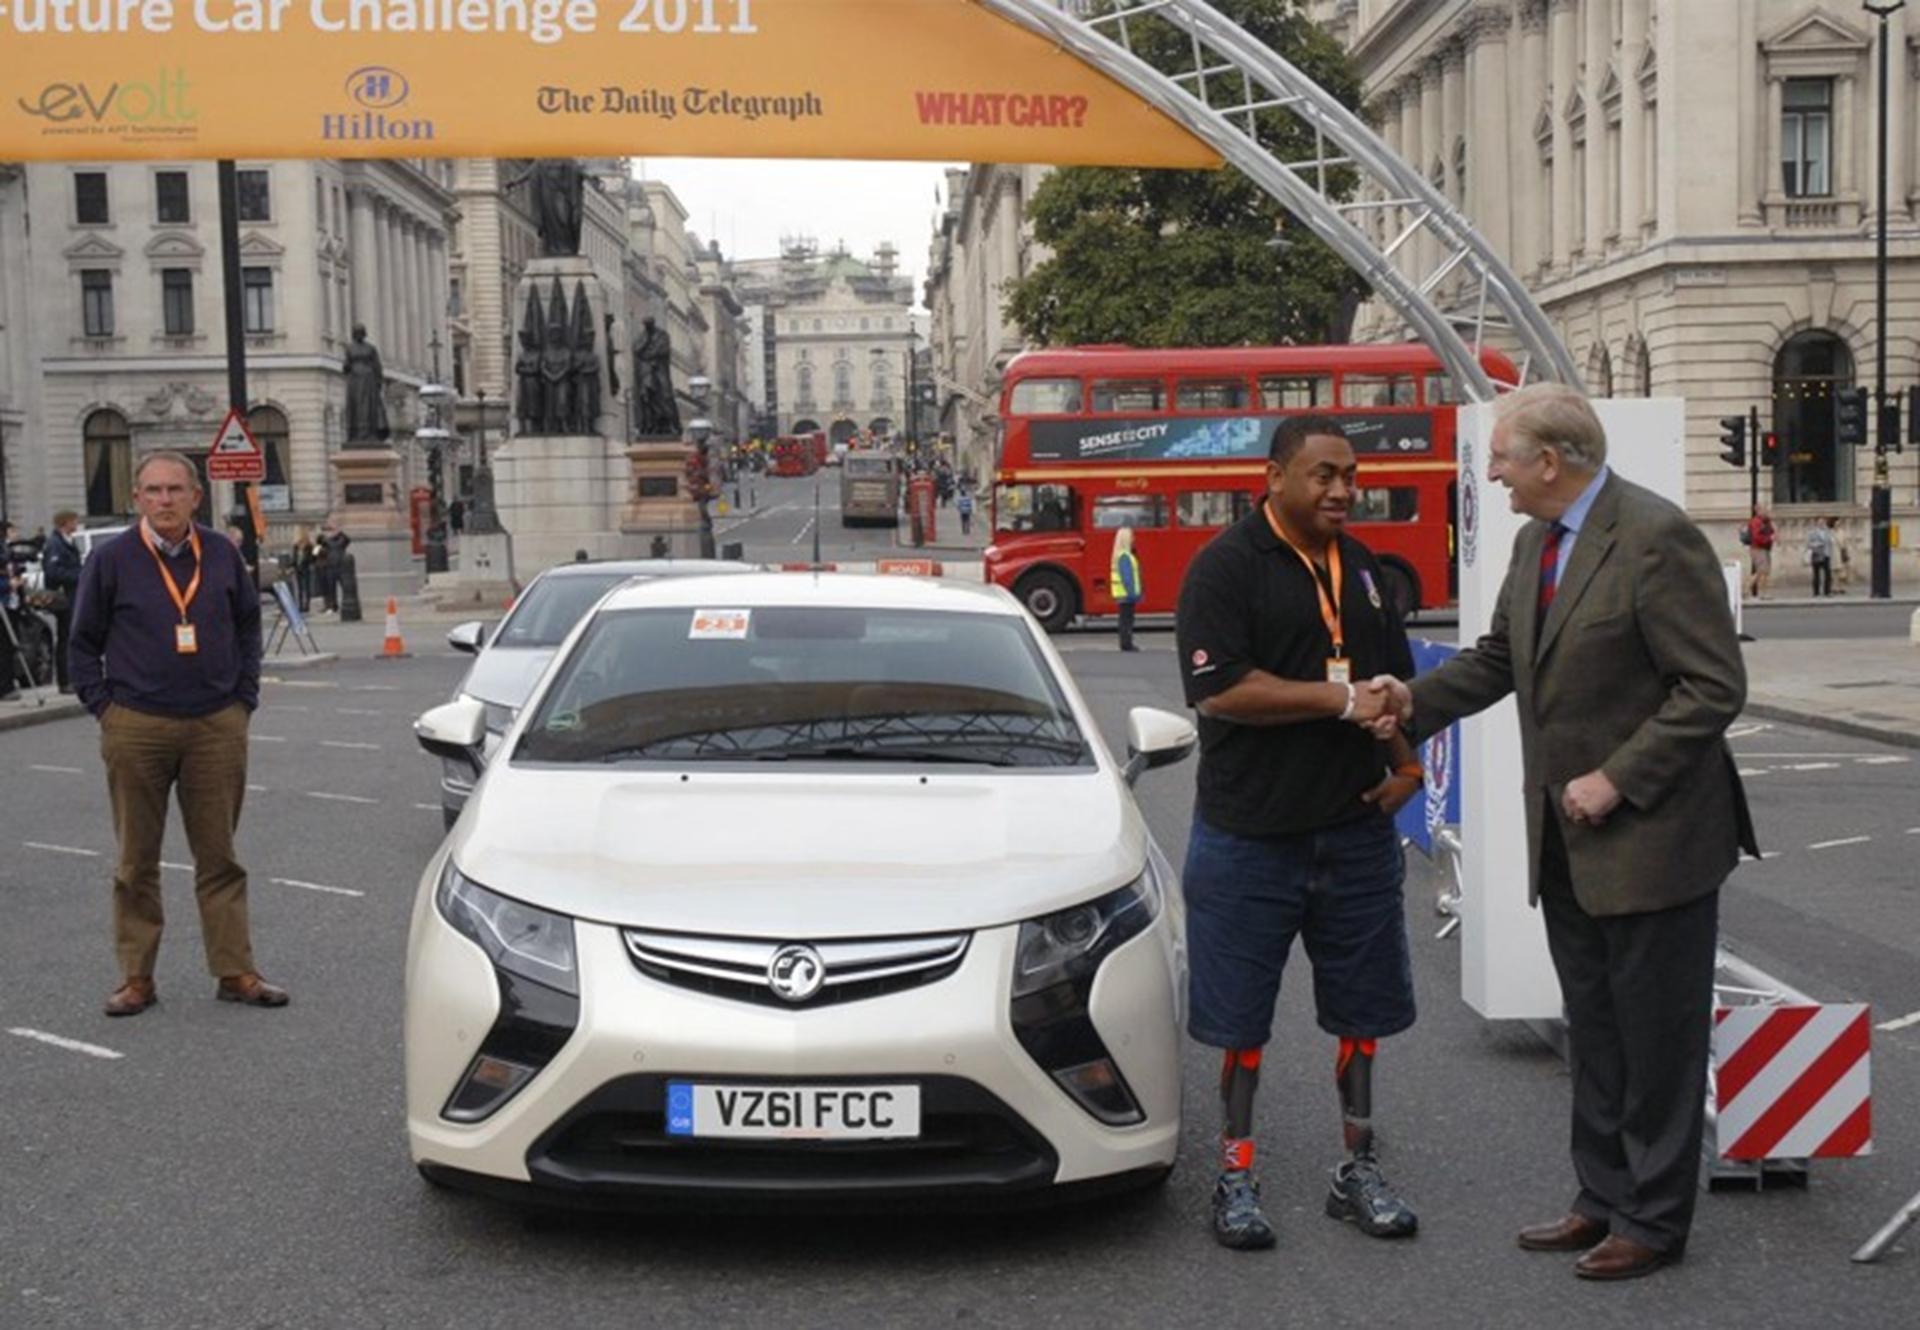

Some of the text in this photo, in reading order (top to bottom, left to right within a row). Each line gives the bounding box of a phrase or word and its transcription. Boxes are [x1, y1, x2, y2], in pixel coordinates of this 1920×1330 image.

[194, 0, 291, 32] Car
[309, 0, 597, 43] Challenge
[618, 0, 757, 33] 2011
[537, 86, 823, 121] The Daily Telegraph
[323, 112, 434, 140] Hilton
[1079, 431, 1121, 450] SENSE
[1136, 424, 1168, 440] CITY
[715, 1090, 893, 1128] VZ61 FCC
